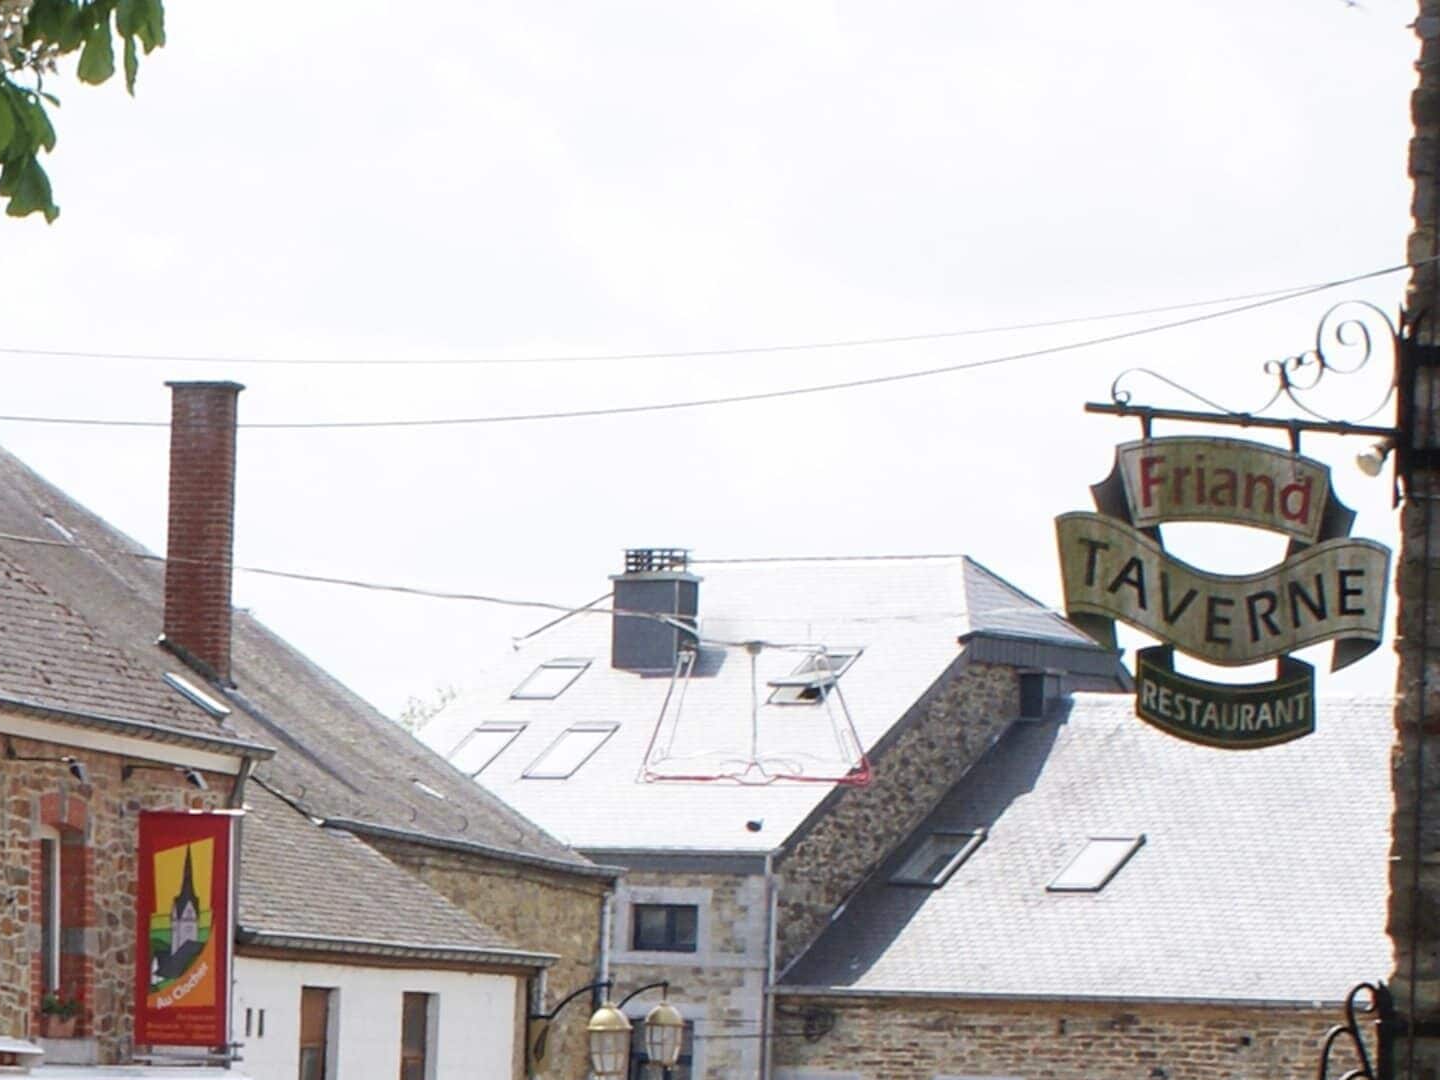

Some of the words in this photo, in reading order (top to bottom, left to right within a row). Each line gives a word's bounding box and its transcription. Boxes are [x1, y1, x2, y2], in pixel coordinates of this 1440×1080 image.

[1140, 454, 1314, 525] Friand
[1081, 539, 1365, 644] TAVERNE
[1140, 678, 1310, 732] RESTAURANT
